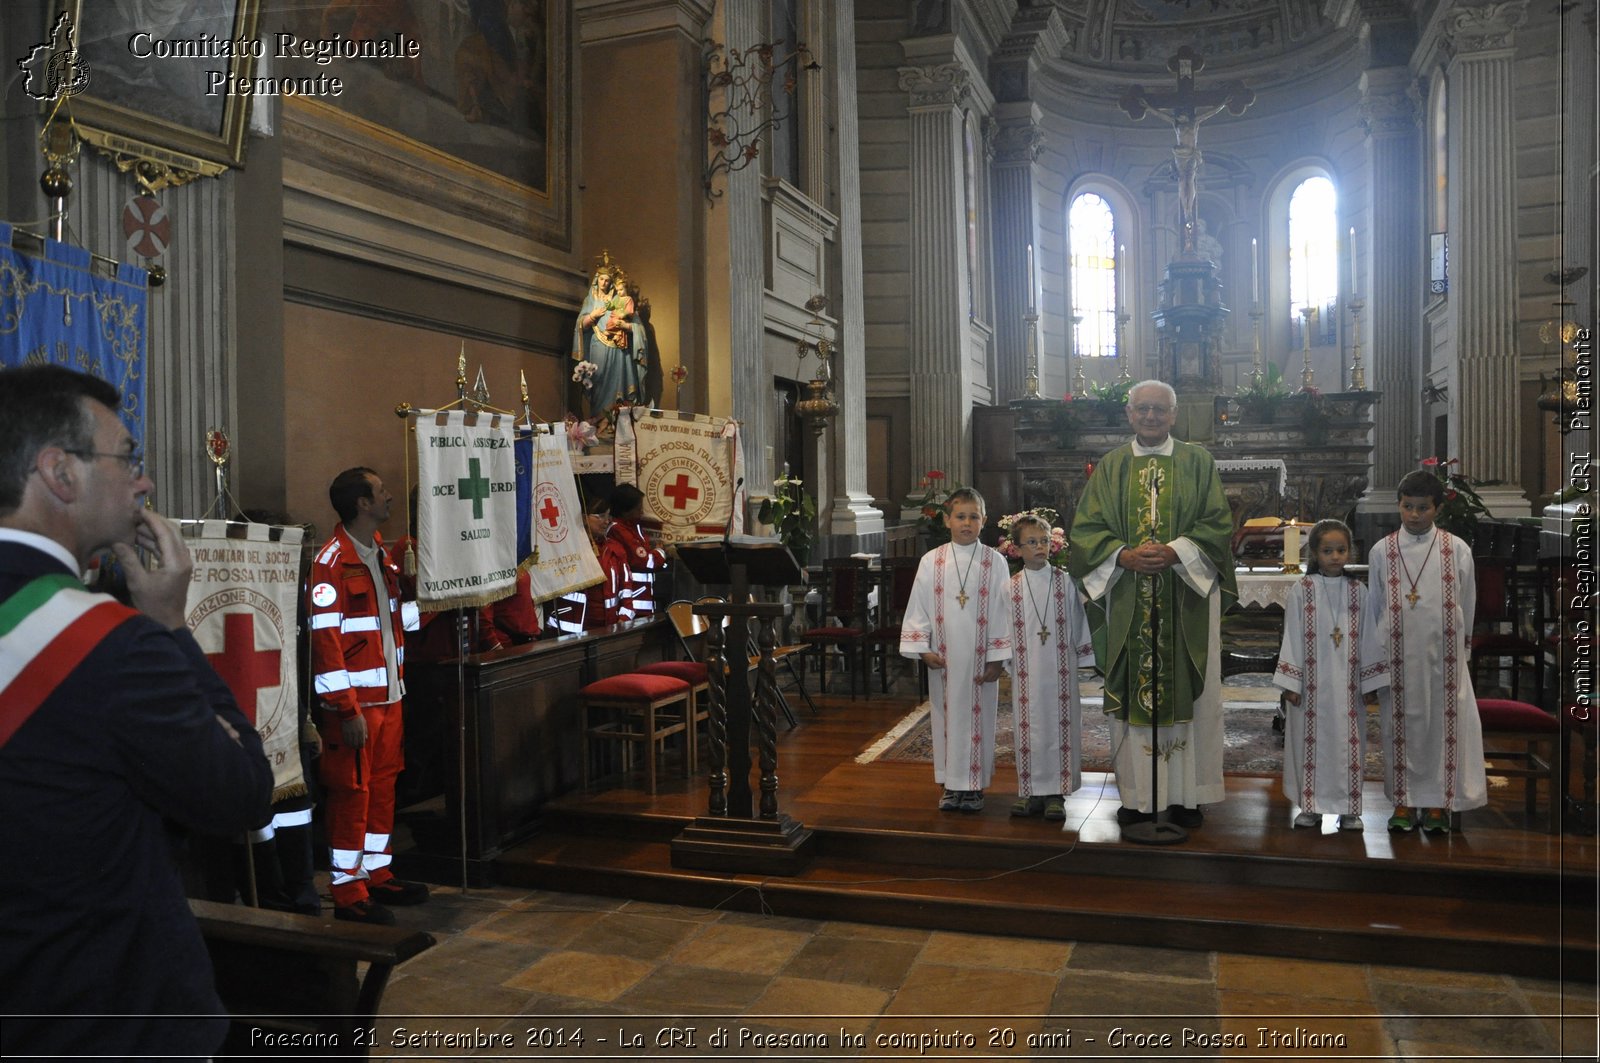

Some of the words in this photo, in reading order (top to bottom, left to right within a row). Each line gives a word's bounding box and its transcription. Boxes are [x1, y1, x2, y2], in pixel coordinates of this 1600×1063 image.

[660, 441, 695, 454] ROSSA
[697, 447, 728, 488] ITALIANA
[648, 472, 673, 521] CONVENZIONE
[661, 464, 670, 472] DI
[672, 459, 704, 475] GINEVRA
[702, 475, 711, 485] 22
[195, 548, 245, 564] VOLONTARI
[247, 550, 262, 564] DEL
[208, 568, 254, 583] ROSSA
[248, 593, 257, 604] DI
[275, 751, 286, 766] DI
